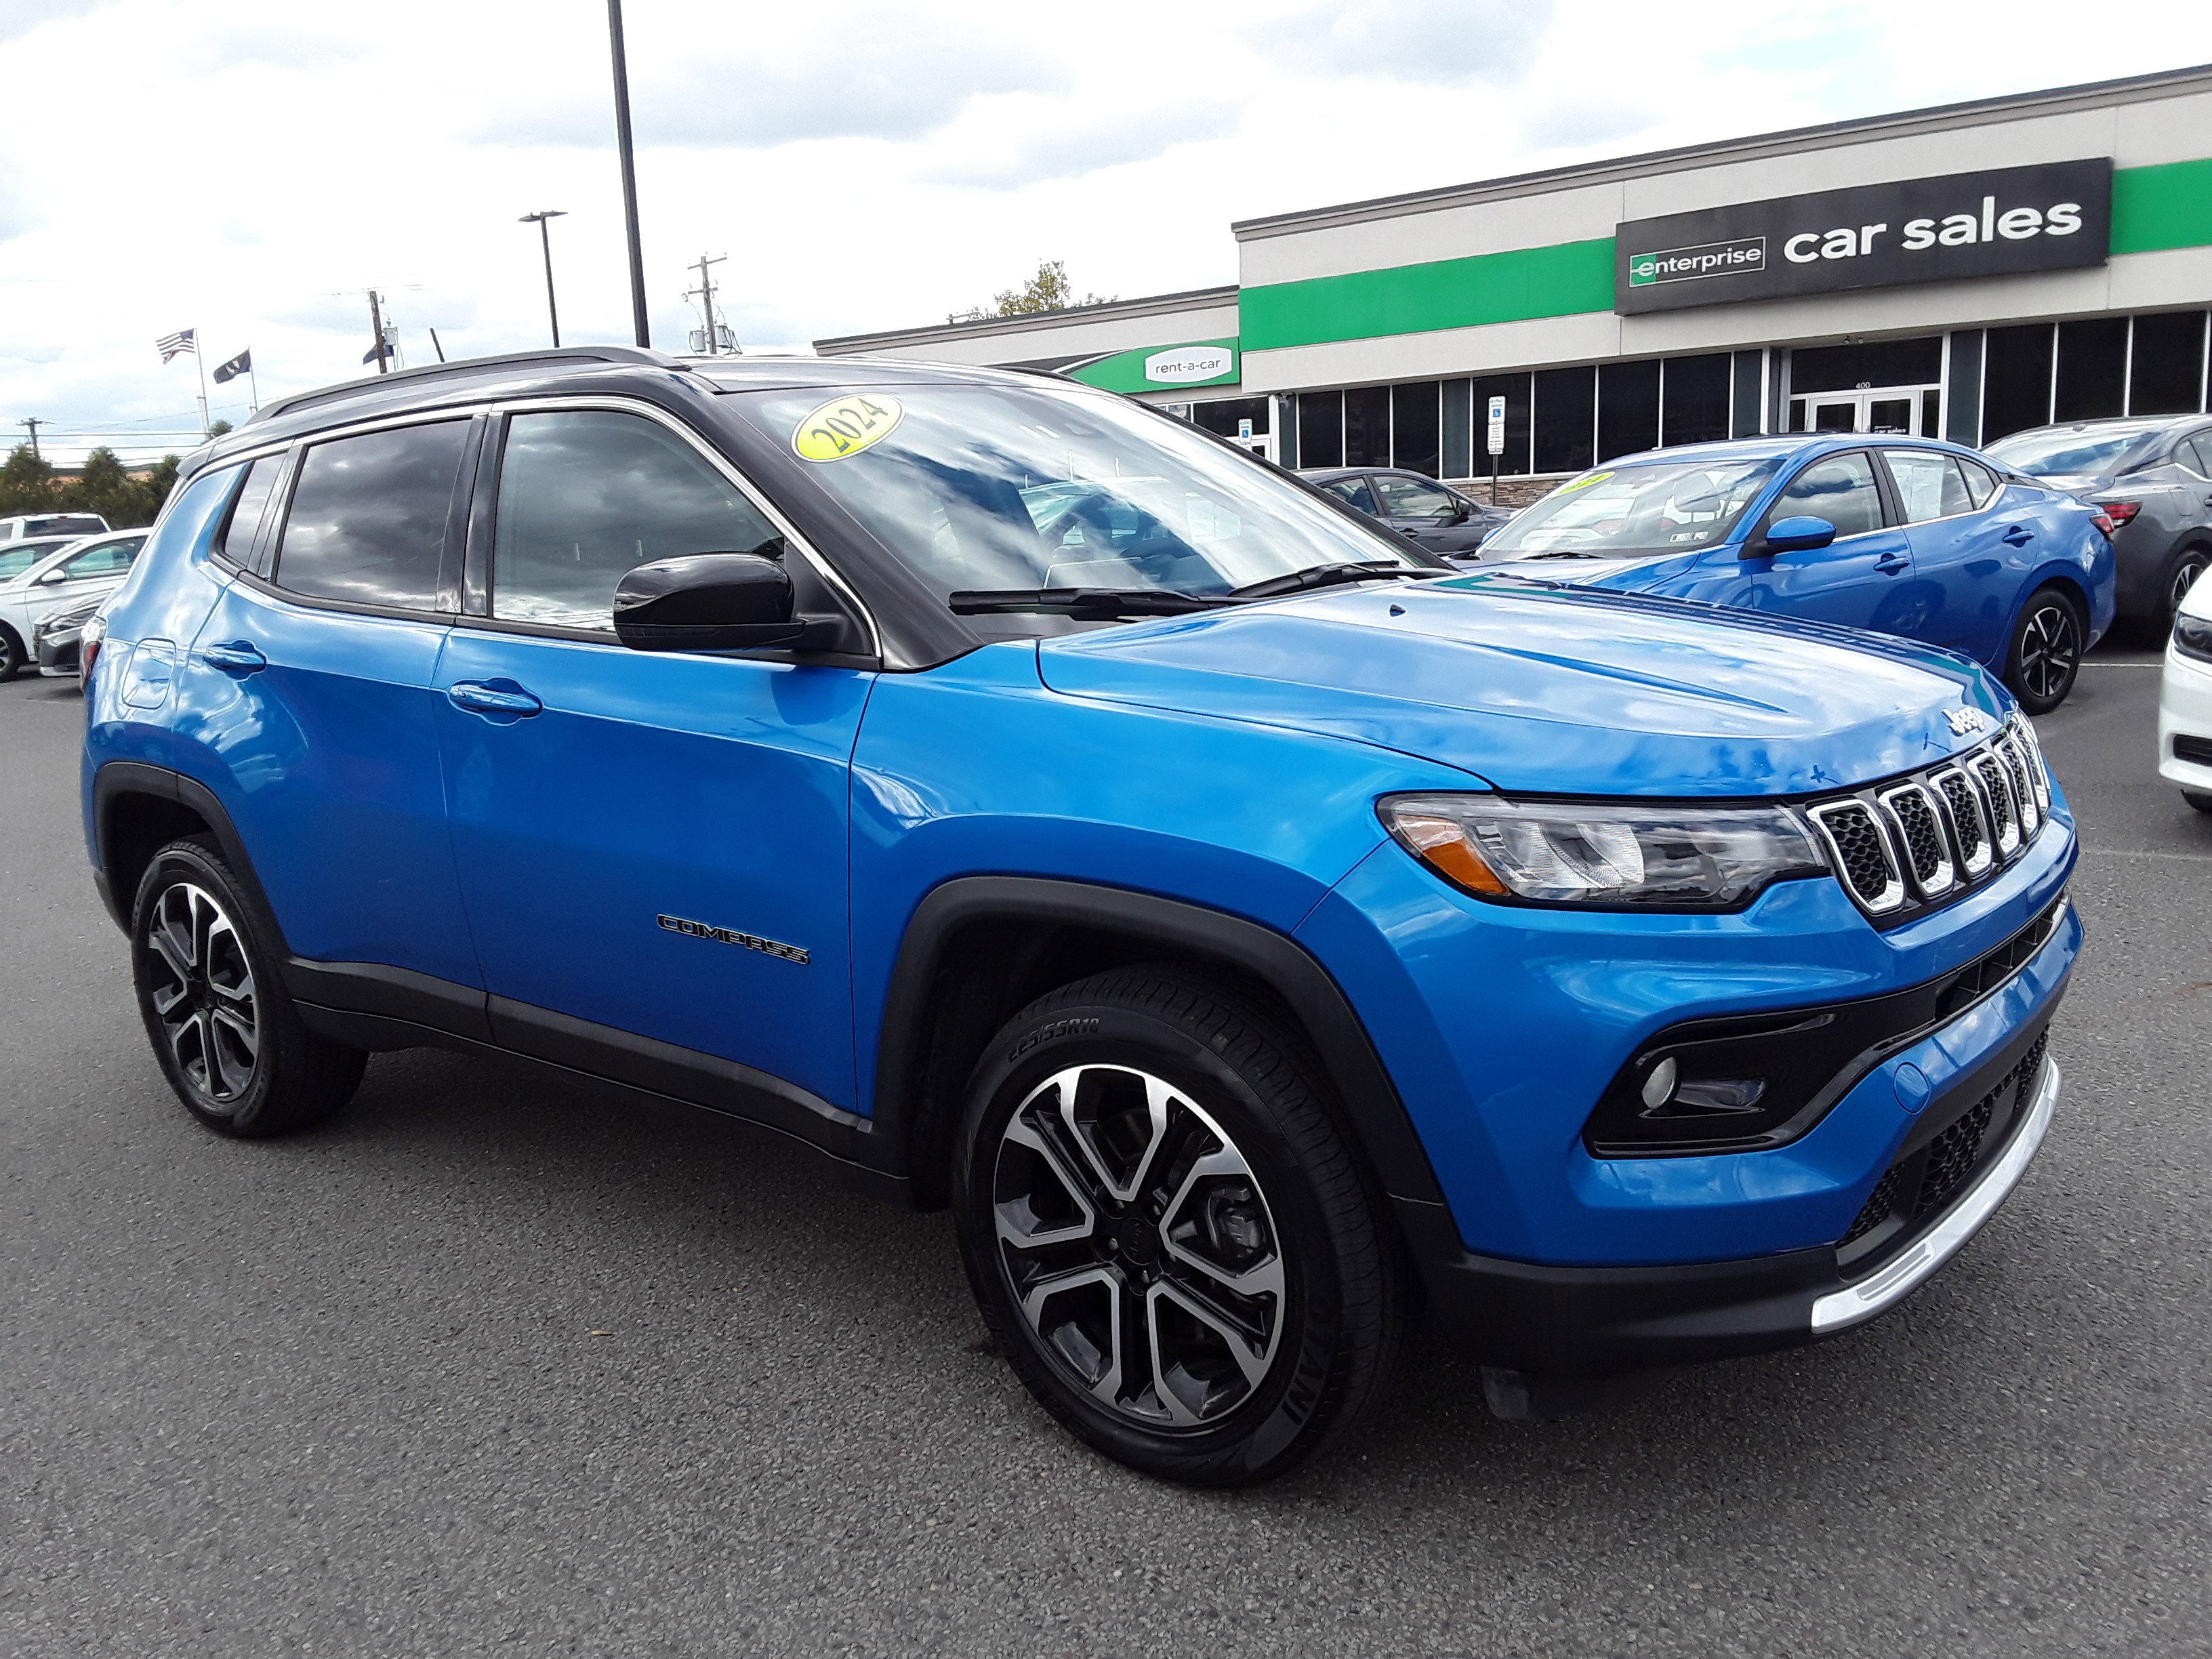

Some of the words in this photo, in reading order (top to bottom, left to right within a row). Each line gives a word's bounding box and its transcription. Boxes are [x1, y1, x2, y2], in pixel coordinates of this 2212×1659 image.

[1632, 247, 1762, 277] enterprise
[1784, 223, 1887, 264] car
[1902, 195, 2083, 251] sales
[1155, 359, 1221, 373] rent-a-car
[811, 397, 888, 453] 2024
[1941, 706, 1986, 737] Jeep
[656, 914, 809, 964] COMPASS
